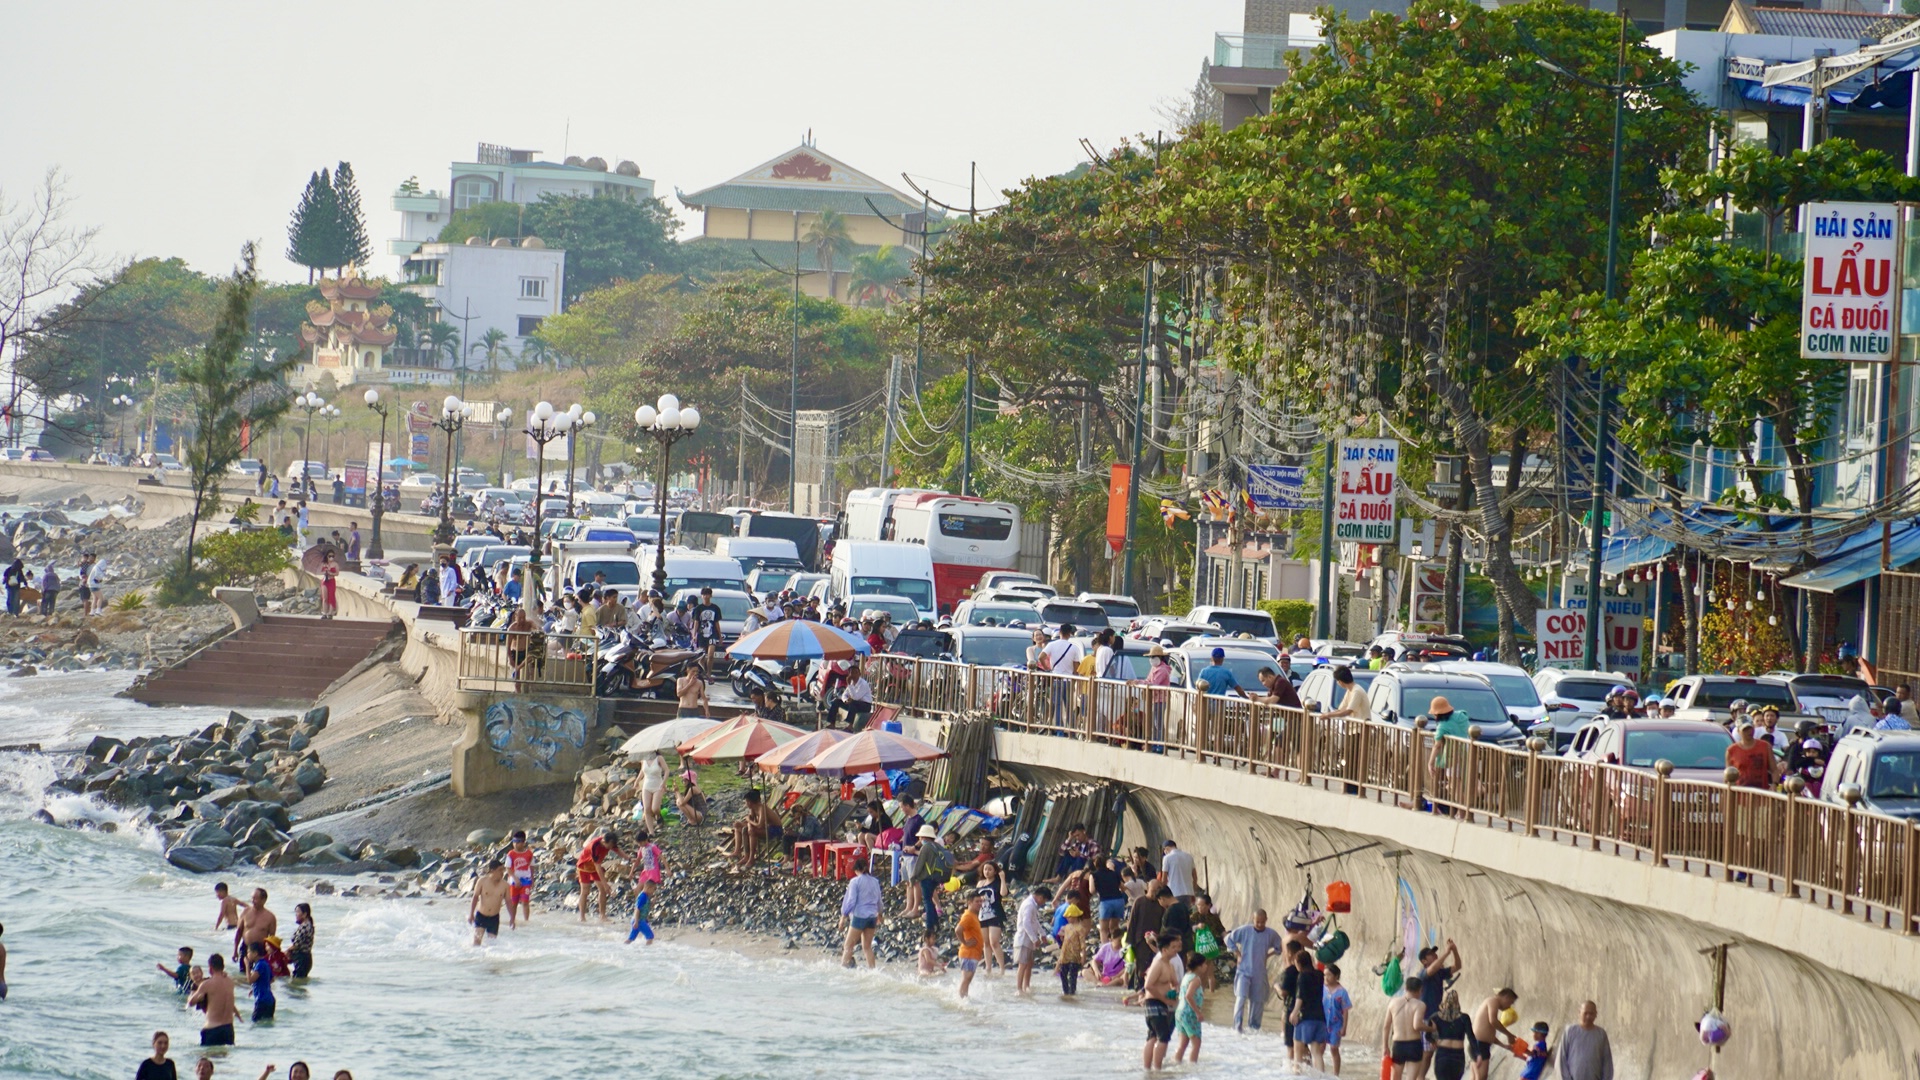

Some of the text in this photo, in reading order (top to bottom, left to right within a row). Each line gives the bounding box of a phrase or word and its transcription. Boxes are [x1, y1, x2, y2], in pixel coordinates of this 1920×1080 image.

[1815, 211, 1892, 239] HẢI SẢN
[1812, 242, 1891, 297] LẨU
[1809, 301, 1889, 331] CÁ ĐUỐI
[1807, 333, 1889, 354] CƠM NIÊU
[1368, 444, 1394, 461] SẢN
[1341, 464, 1393, 495] LẨU
[1339, 498, 1392, 521] CÁ ĐUỐI
[1337, 522, 1392, 539] CƠM NIÊU
[1606, 599, 1642, 615] NIÊU
[1543, 635, 1598, 660] NIÊ
